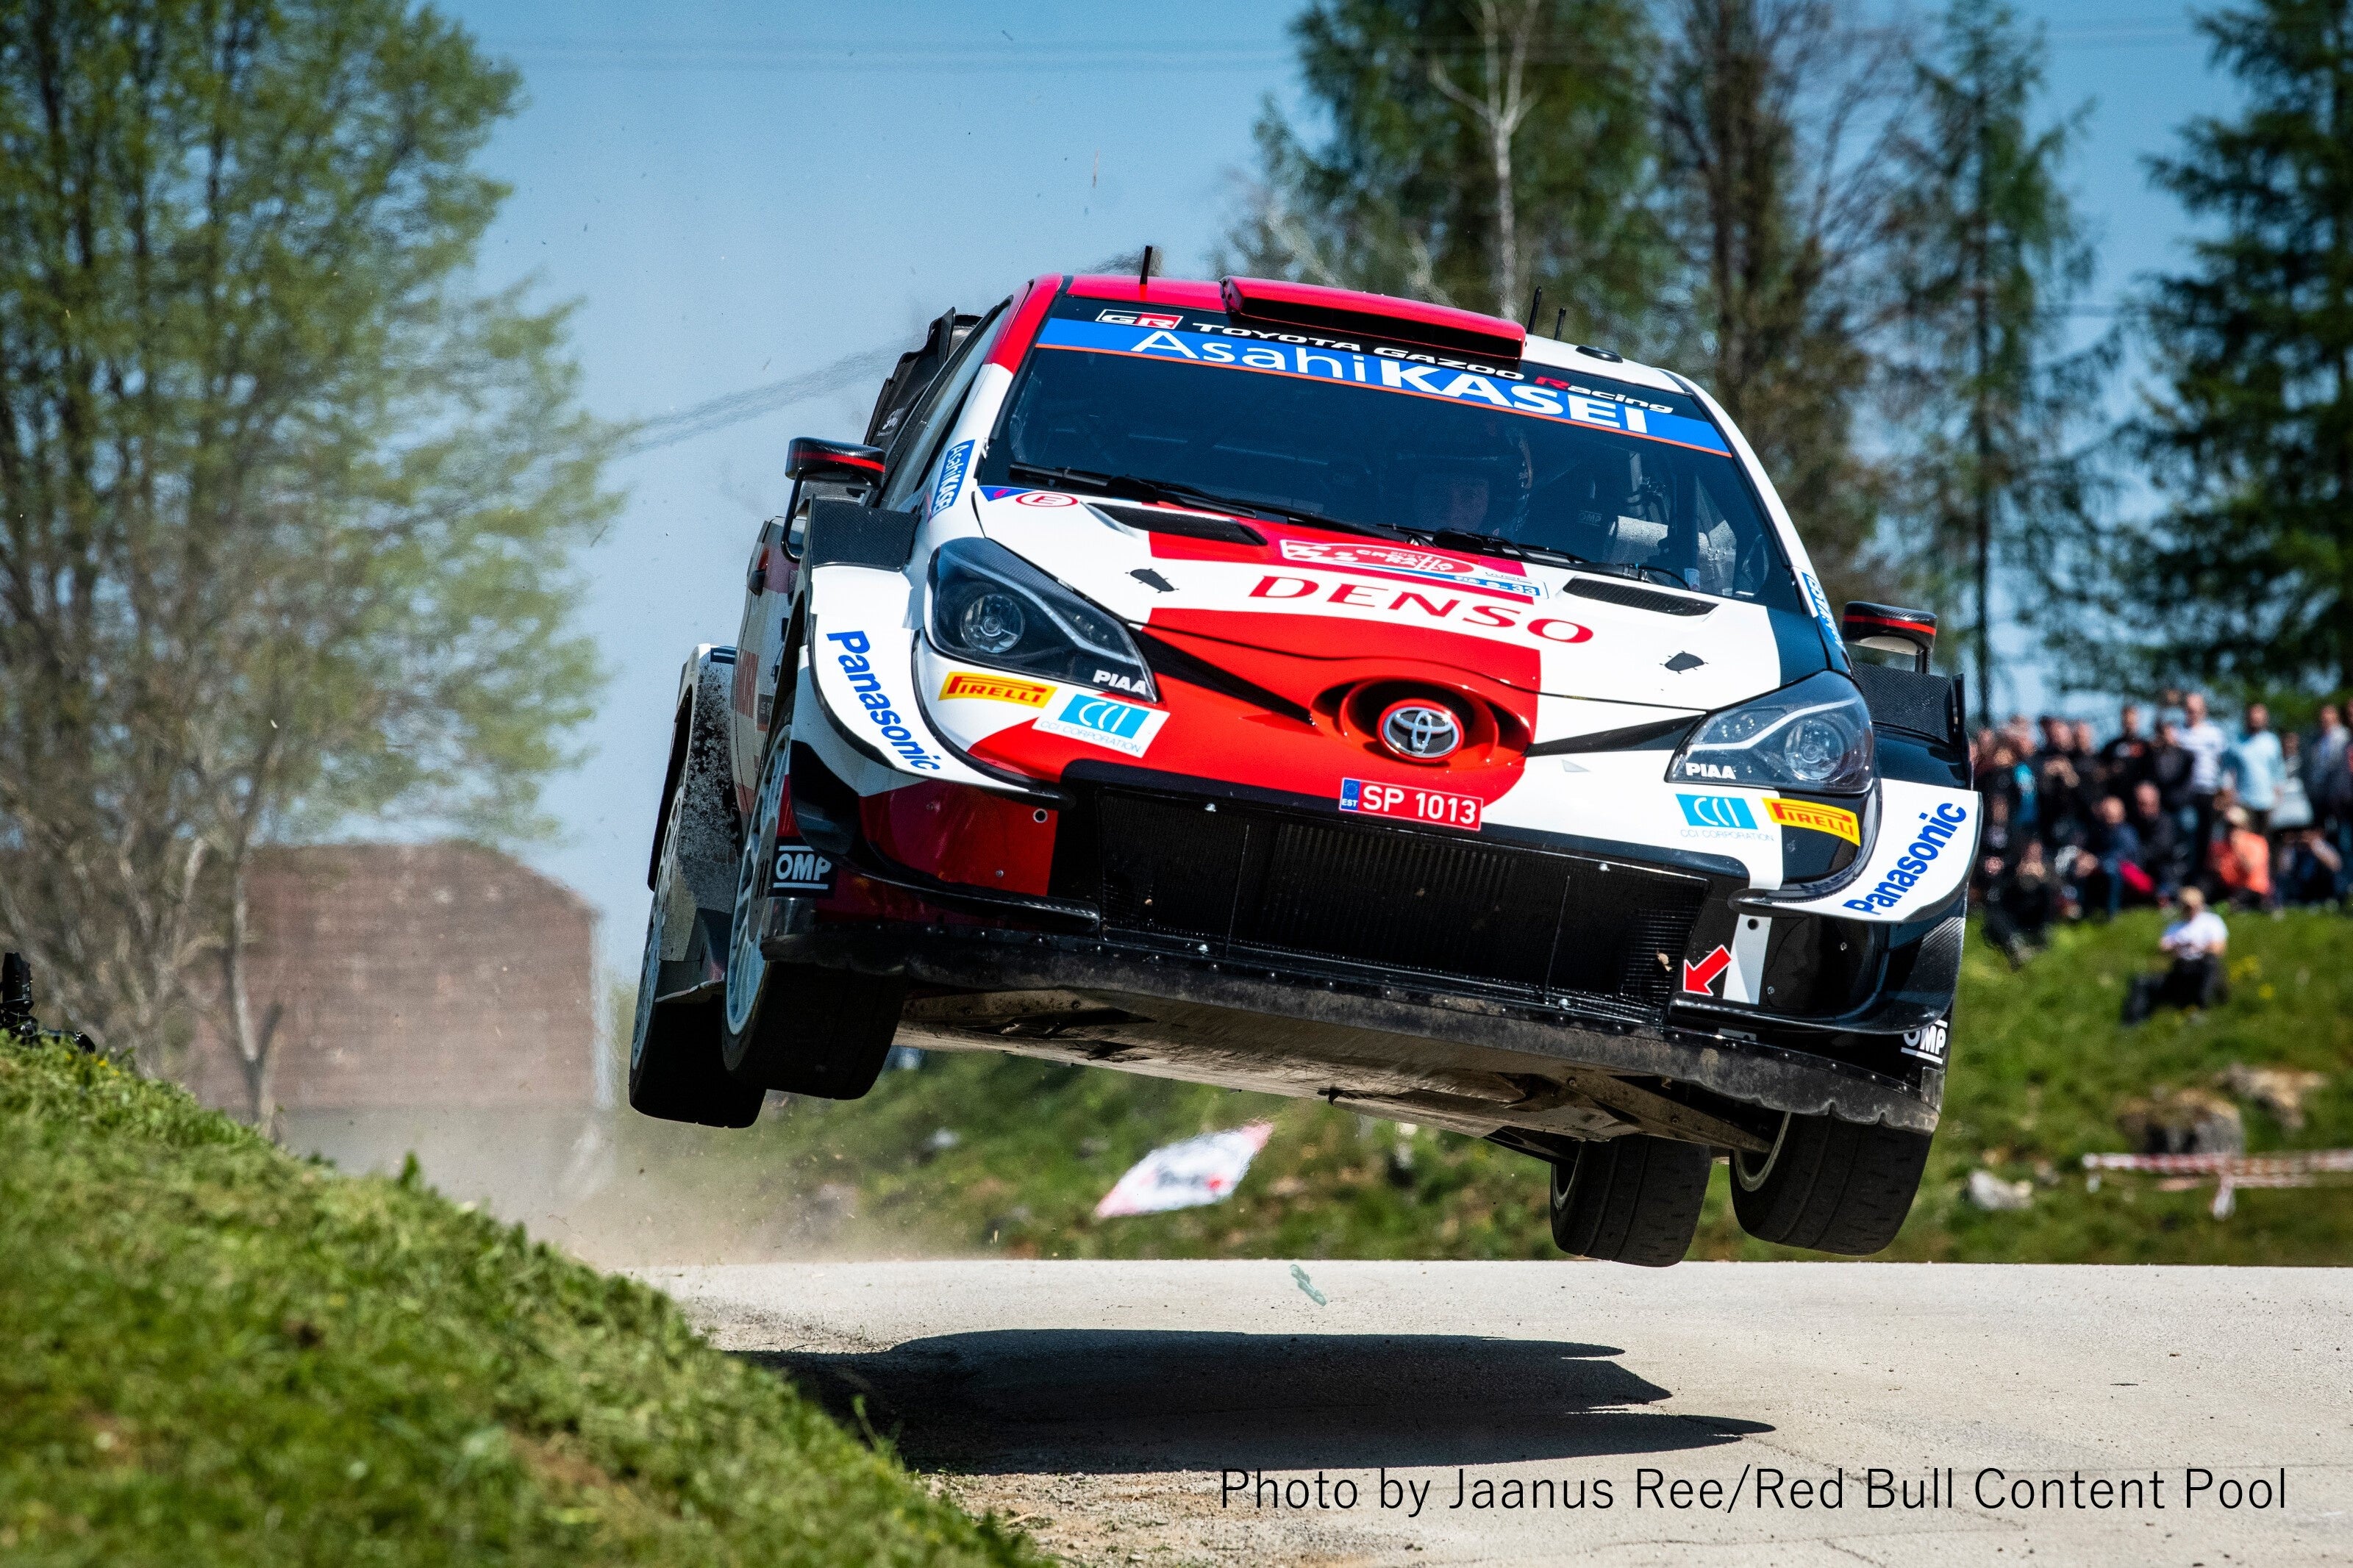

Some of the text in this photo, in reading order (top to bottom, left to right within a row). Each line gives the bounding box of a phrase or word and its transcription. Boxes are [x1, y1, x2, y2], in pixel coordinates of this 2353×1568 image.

[1100, 312, 1674, 414] GR TOYOTA GAZOO Racing
[1512, 584, 1537, 595] 33
[1249, 576, 1593, 643] DENSO
[947, 676, 1046, 703] PIRELLI
[1093, 670, 1147, 695] PIAA
[826, 631, 940, 770] Panasonic
[1079, 701, 1130, 733] CCI
[1040, 720, 1142, 753] CCI CORPORATION
[1685, 762, 1736, 780] PIAA
[1341, 798, 1358, 808] EST
[1363, 785, 1476, 825] SP 1013
[1694, 797, 1740, 827] CCI
[1771, 801, 1854, 836] PIRELLI
[1680, 829, 1774, 842] CCI CORPORATION
[776, 853, 832, 881] OMP
[1842, 803, 1967, 915] Panasonic
